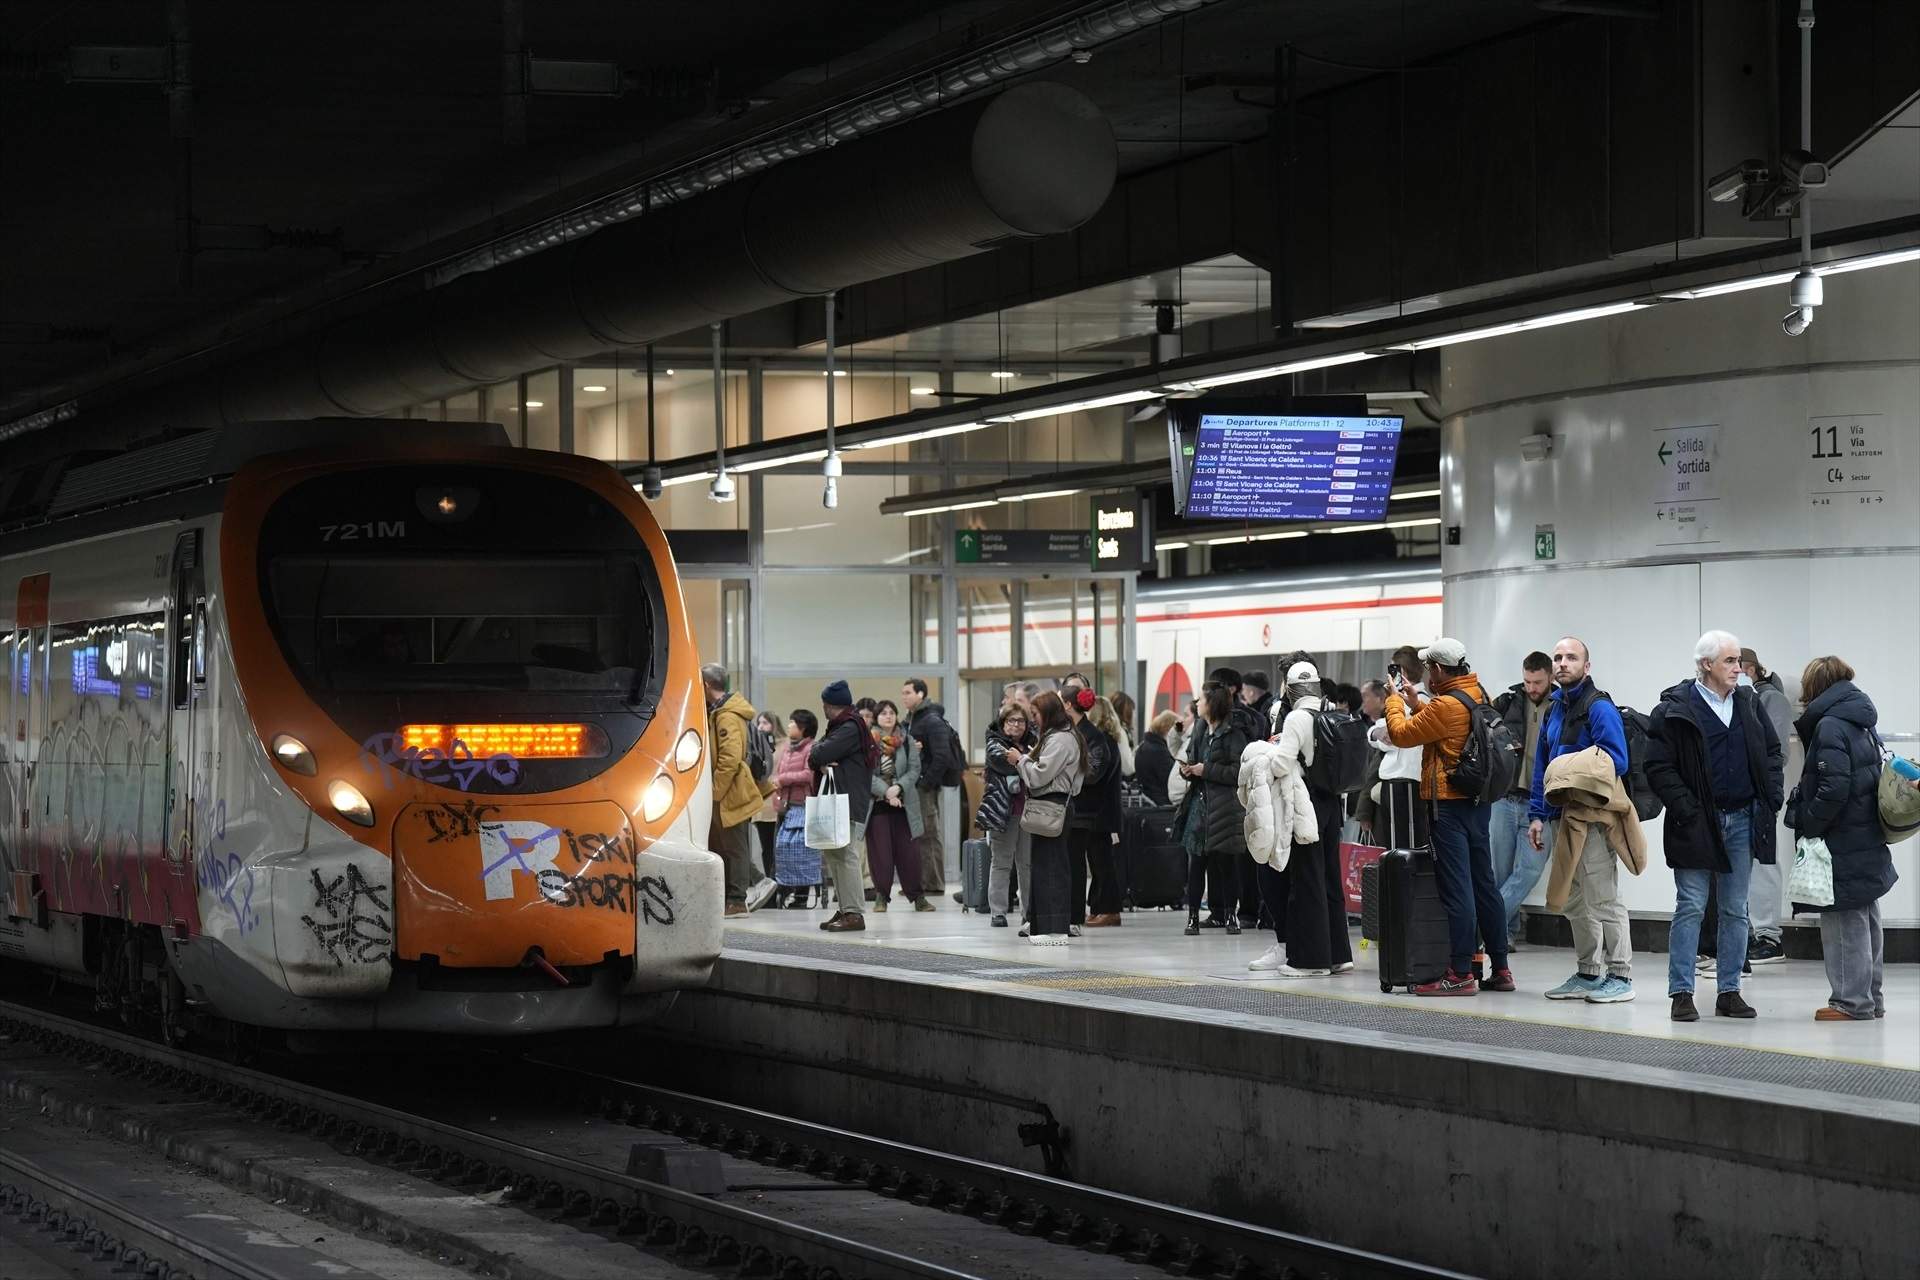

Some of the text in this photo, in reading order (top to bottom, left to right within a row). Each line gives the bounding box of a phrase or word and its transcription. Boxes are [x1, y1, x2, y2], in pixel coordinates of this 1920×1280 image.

[1226, 418, 1278, 427] Departures
[1280, 419, 1320, 428] Platforms
[1366, 419, 1392, 427] 10:43
[1677, 438, 1704, 453] Salida
[1811, 425, 1843, 458] 11
[1677, 459, 1710, 474] Sortida
[1827, 468, 1872, 482] C4 Sector
[1677, 482, 1690, 491] EXIT
[319, 520, 406, 541] 721M
[479, 820, 570, 901] R
